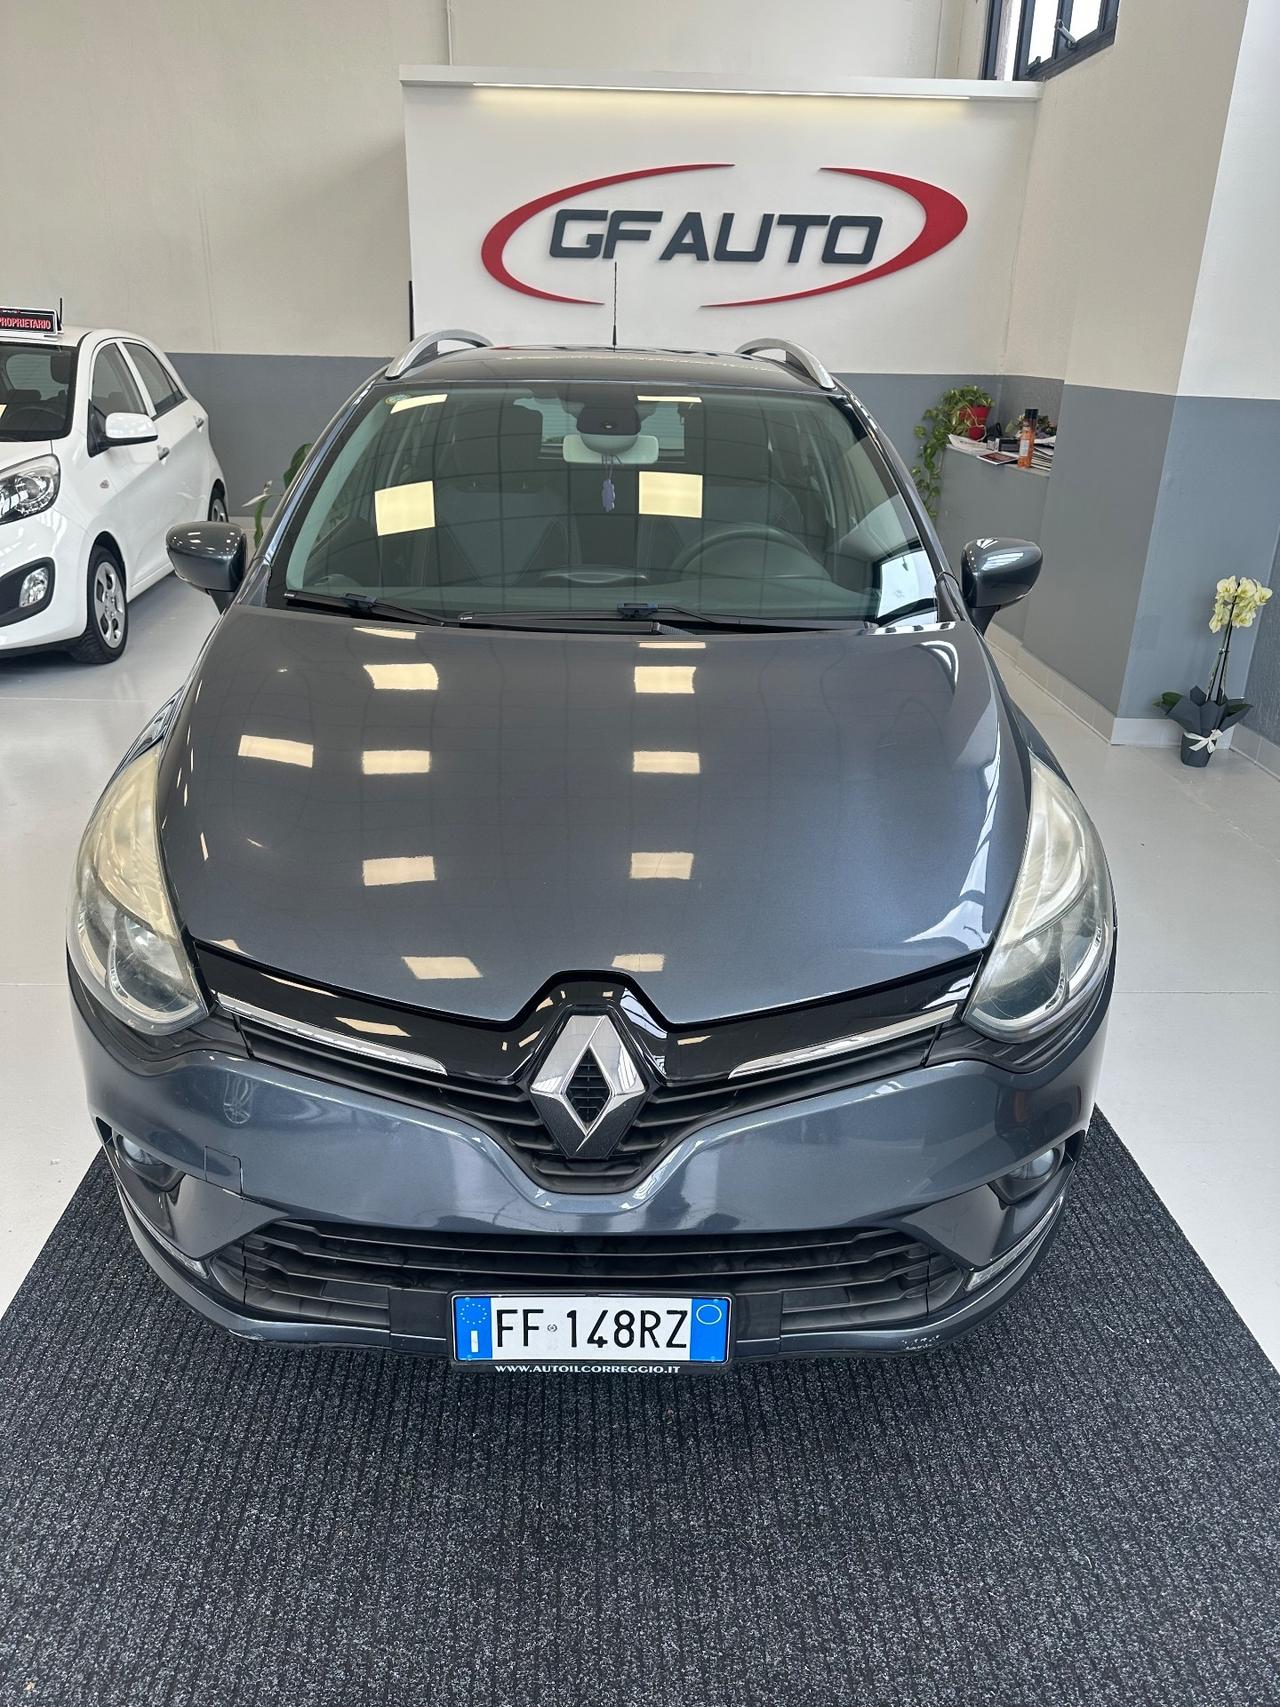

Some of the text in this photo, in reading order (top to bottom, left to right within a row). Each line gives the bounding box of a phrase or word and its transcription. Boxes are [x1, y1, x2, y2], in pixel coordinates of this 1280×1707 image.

[658, 211, 883, 265] AUTO
[496, 1308, 688, 1348] FF 148RZ
[494, 1364, 681, 1374] WWW.AUTOILCORREGGIO.IT
